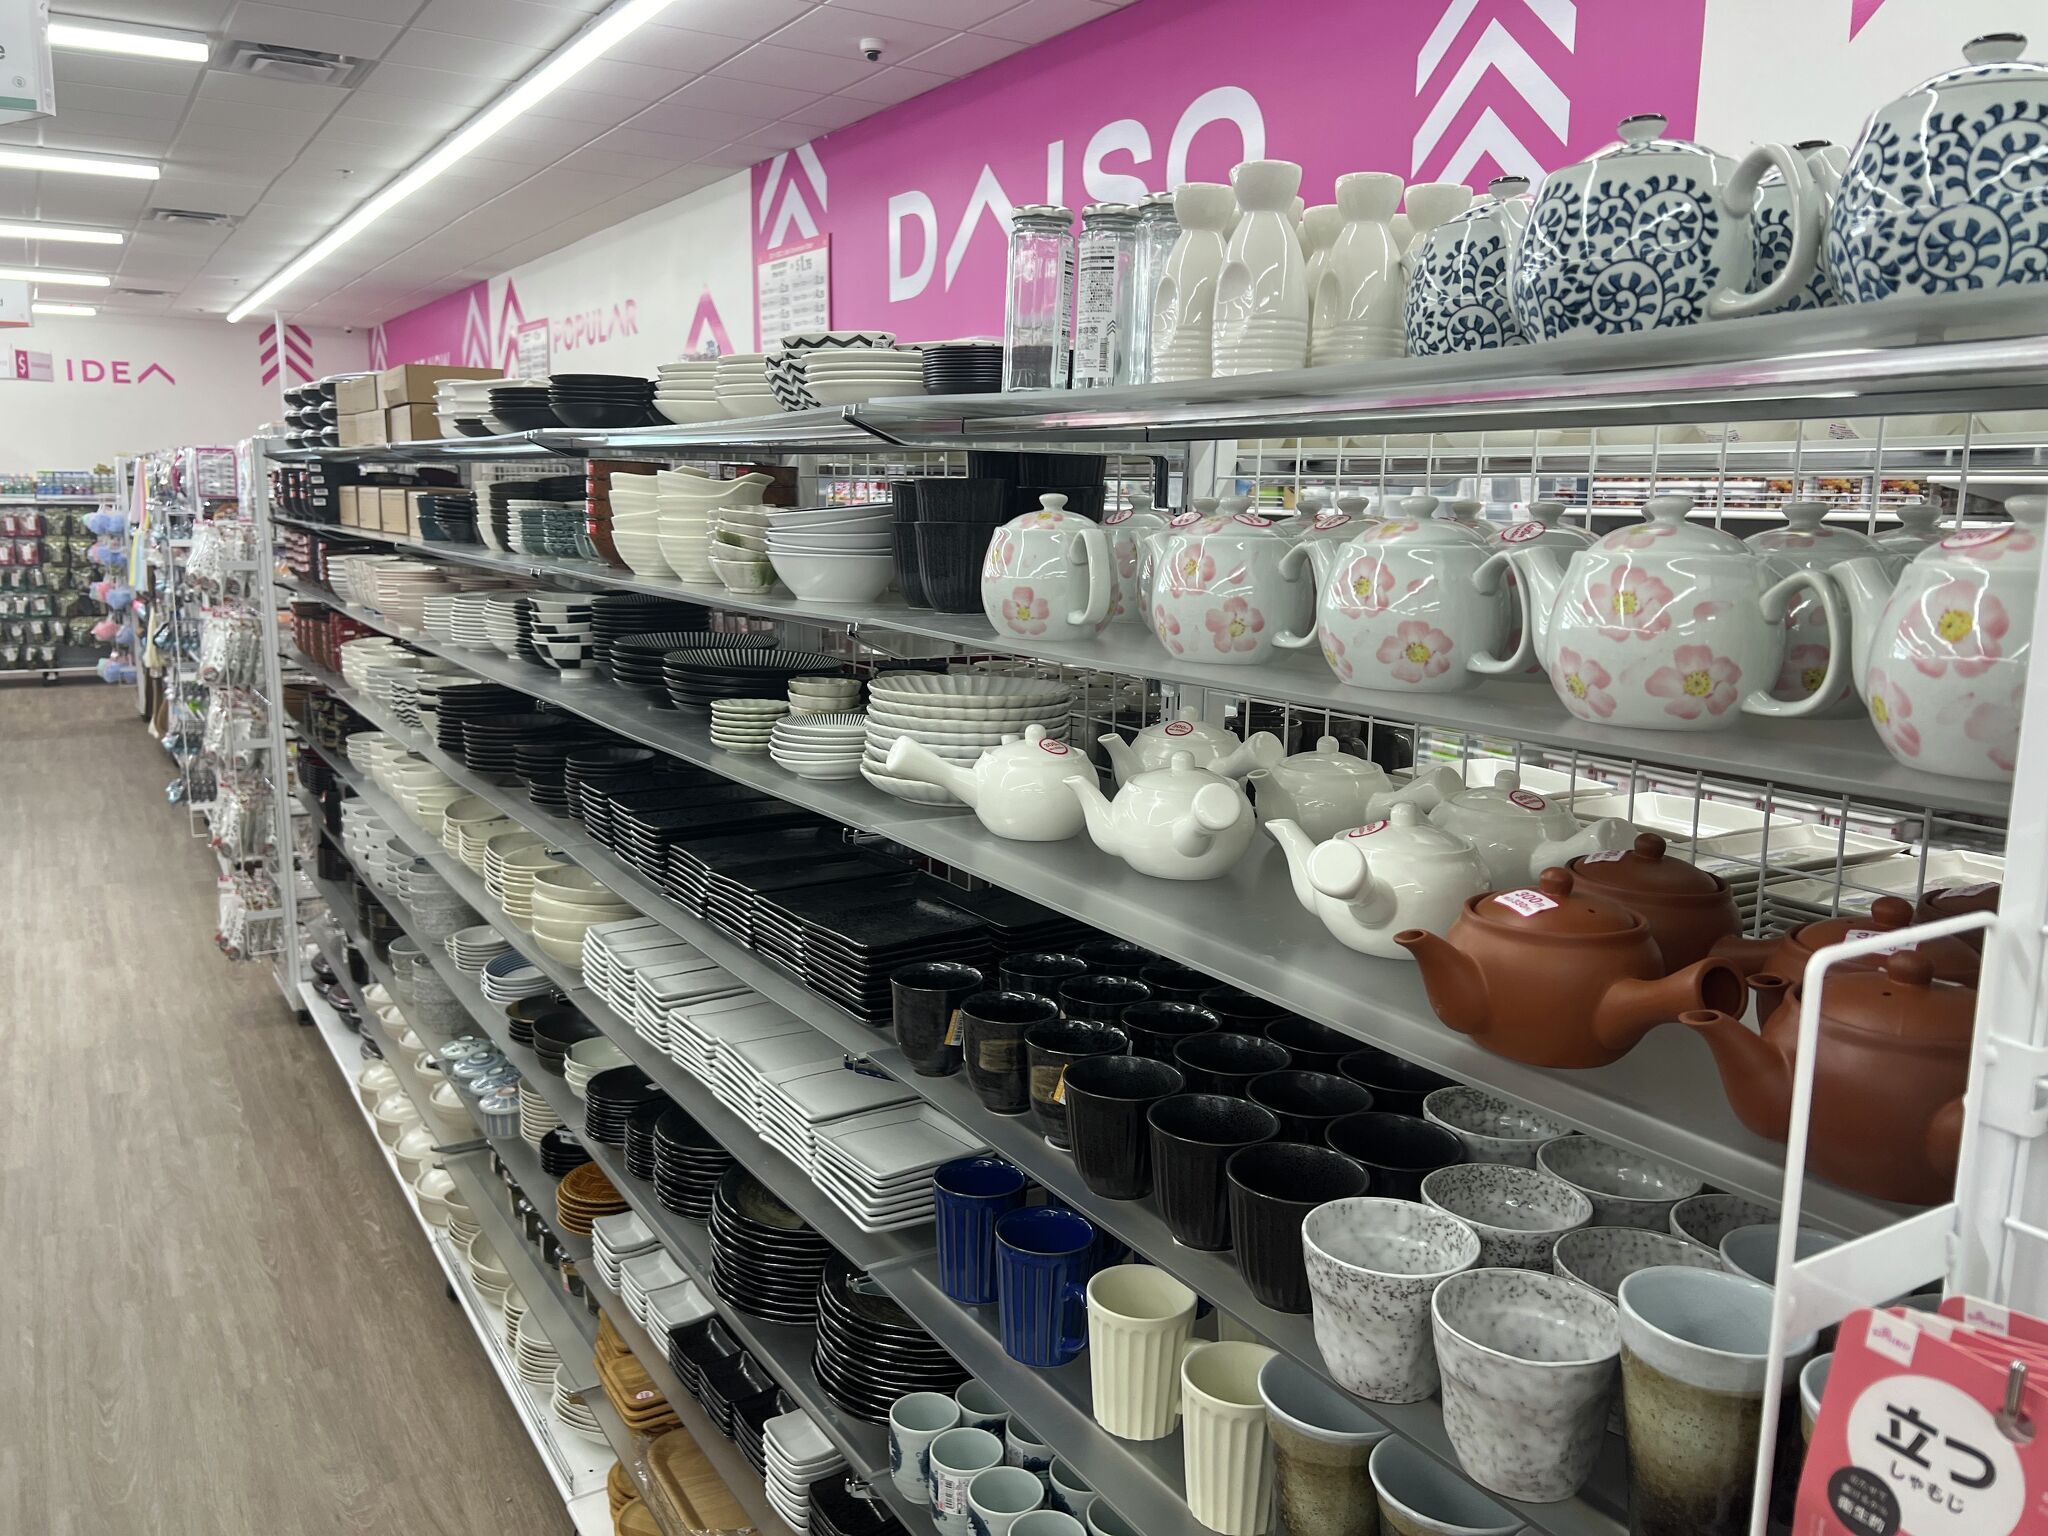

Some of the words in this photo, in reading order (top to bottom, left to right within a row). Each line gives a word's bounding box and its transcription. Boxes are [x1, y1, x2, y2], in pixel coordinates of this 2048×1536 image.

[889, 86, 1266, 302] DAISO
[553, 299, 639, 354] POPULAR
[66, 359, 176, 385] IDEA
[1875, 1402, 1997, 1490] 立つ
[1890, 1459, 1964, 1514] しゃもじ
